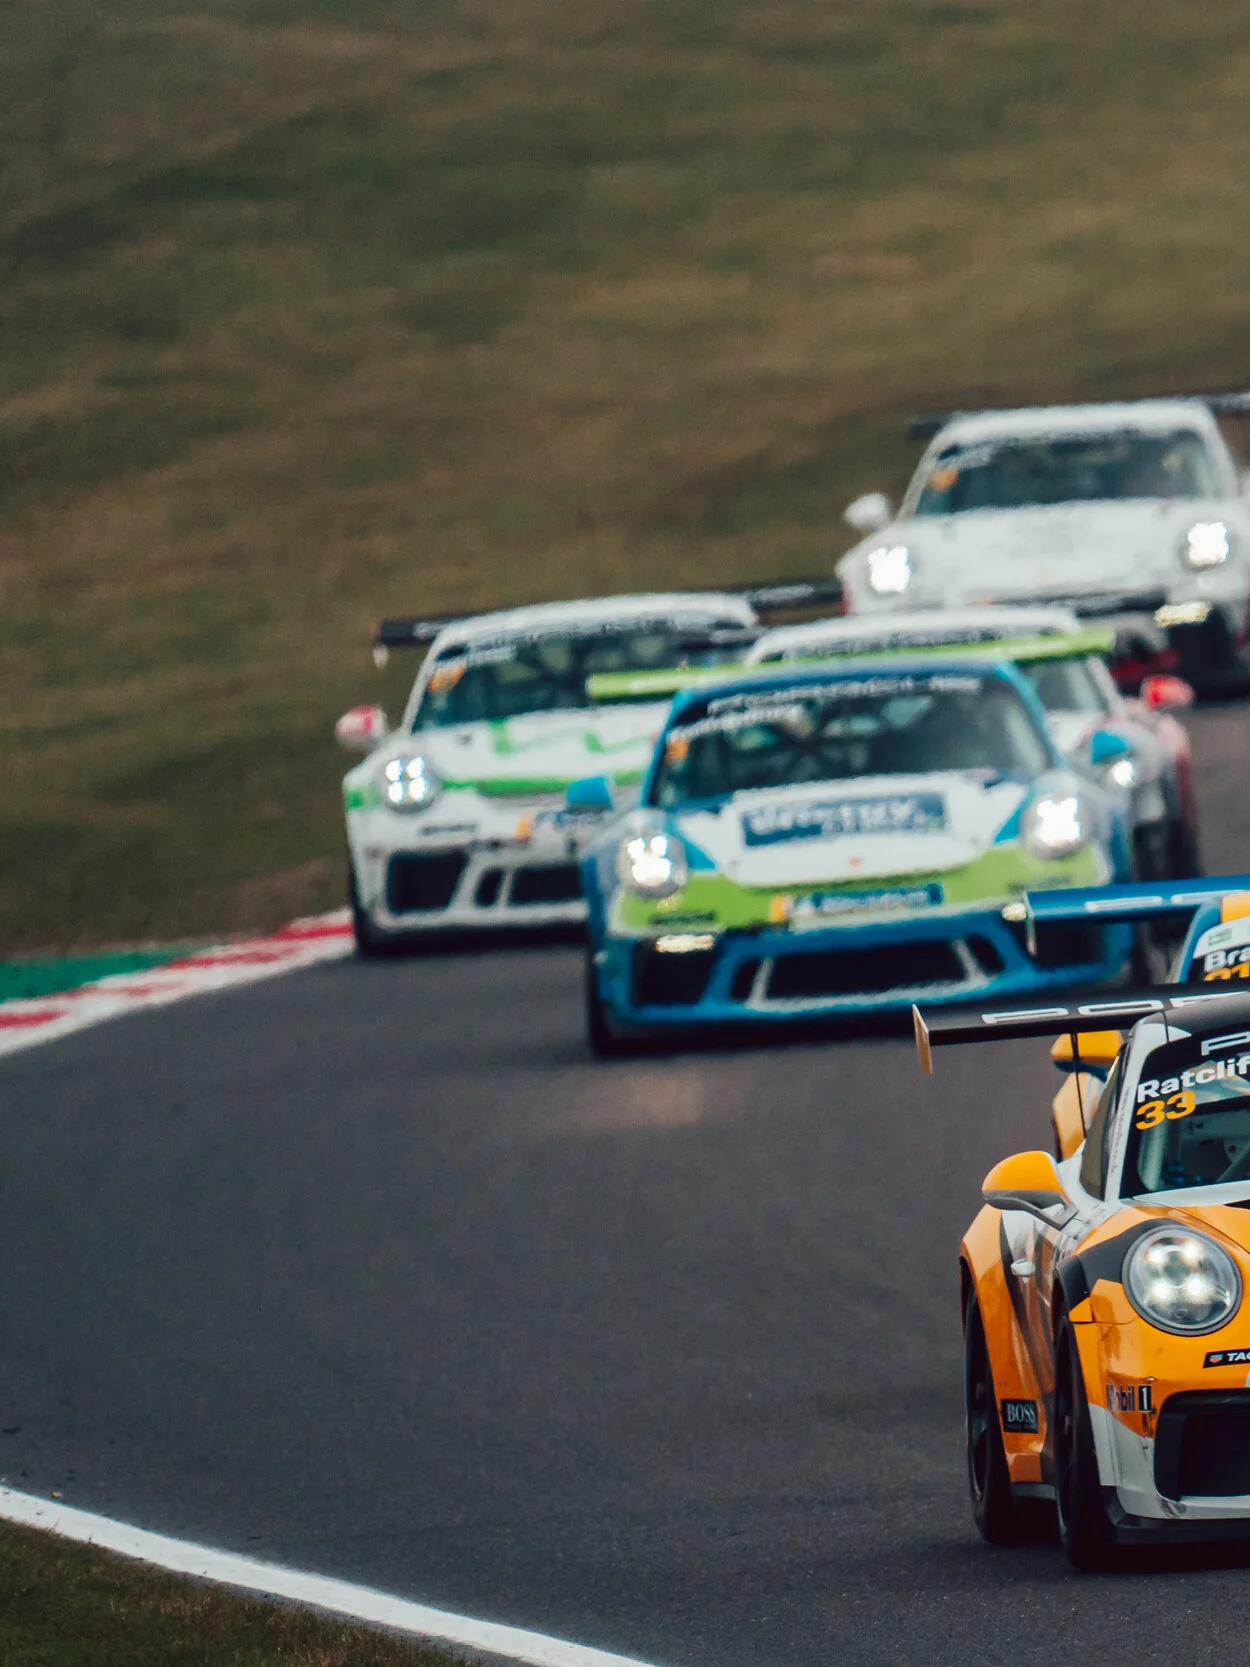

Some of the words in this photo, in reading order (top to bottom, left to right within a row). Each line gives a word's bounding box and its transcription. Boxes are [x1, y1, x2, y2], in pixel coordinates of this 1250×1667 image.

[1135, 1090, 1197, 1130] 33
[1105, 1384, 1136, 1411] Mbil
[1006, 1403, 1036, 1424] BOSS
